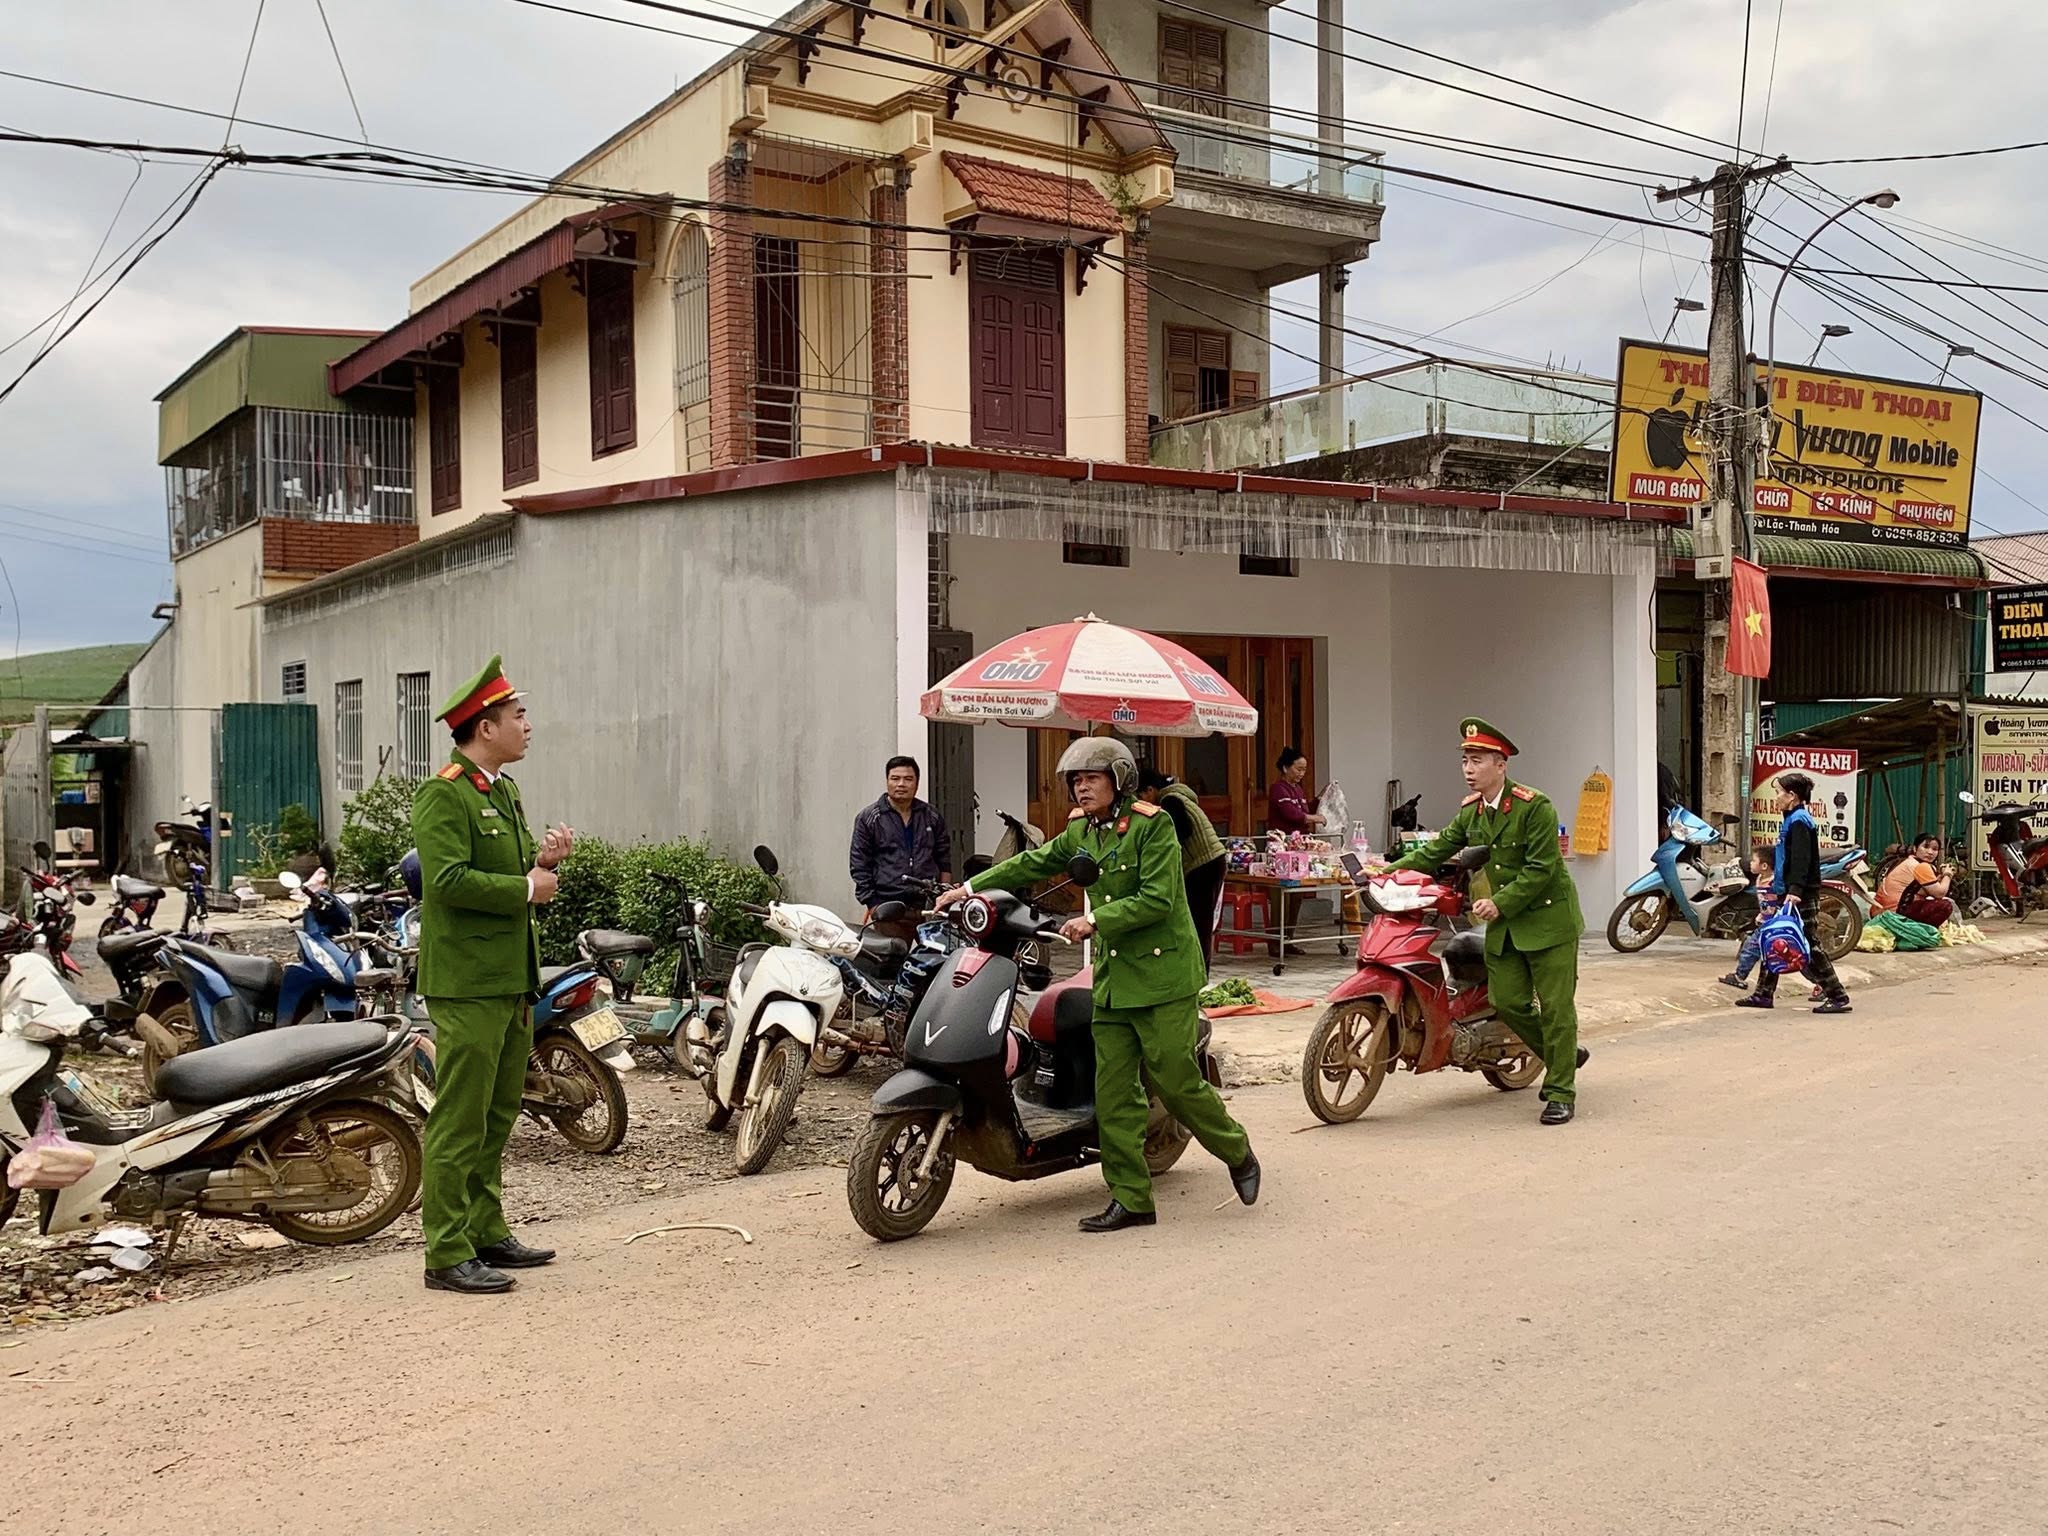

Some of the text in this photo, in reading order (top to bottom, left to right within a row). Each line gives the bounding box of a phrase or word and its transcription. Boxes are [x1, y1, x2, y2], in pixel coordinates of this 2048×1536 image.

[1798, 379, 1863, 412] ĐIỆN
[1872, 390, 1952, 426] THOẠI
[1889, 436, 1959, 467] Mobile
[1634, 478, 1700, 499] MUA BÁN
[1756, 485, 1789, 508] CHỮA
[1815, 492, 1873, 516] ÉP KÍNH
[1899, 503, 1953, 525] PHỤ KIỆN
[1821, 520, 1840, 535] Hóa
[2003, 601, 2044, 621] ĐIỆN
[981, 662, 1048, 681] OMO
[1183, 672, 1227, 695] OMO
[1112, 709, 1136, 722] OMO
[2000, 717, 2025, 730] Hoàng
[1756, 748, 1852, 774] VƯƠNG HẠNH
[1984, 776, 2022, 796] ĐIỆN
[1752, 798, 1768, 814] MUA
[1767, 820, 1778, 833] PIN
